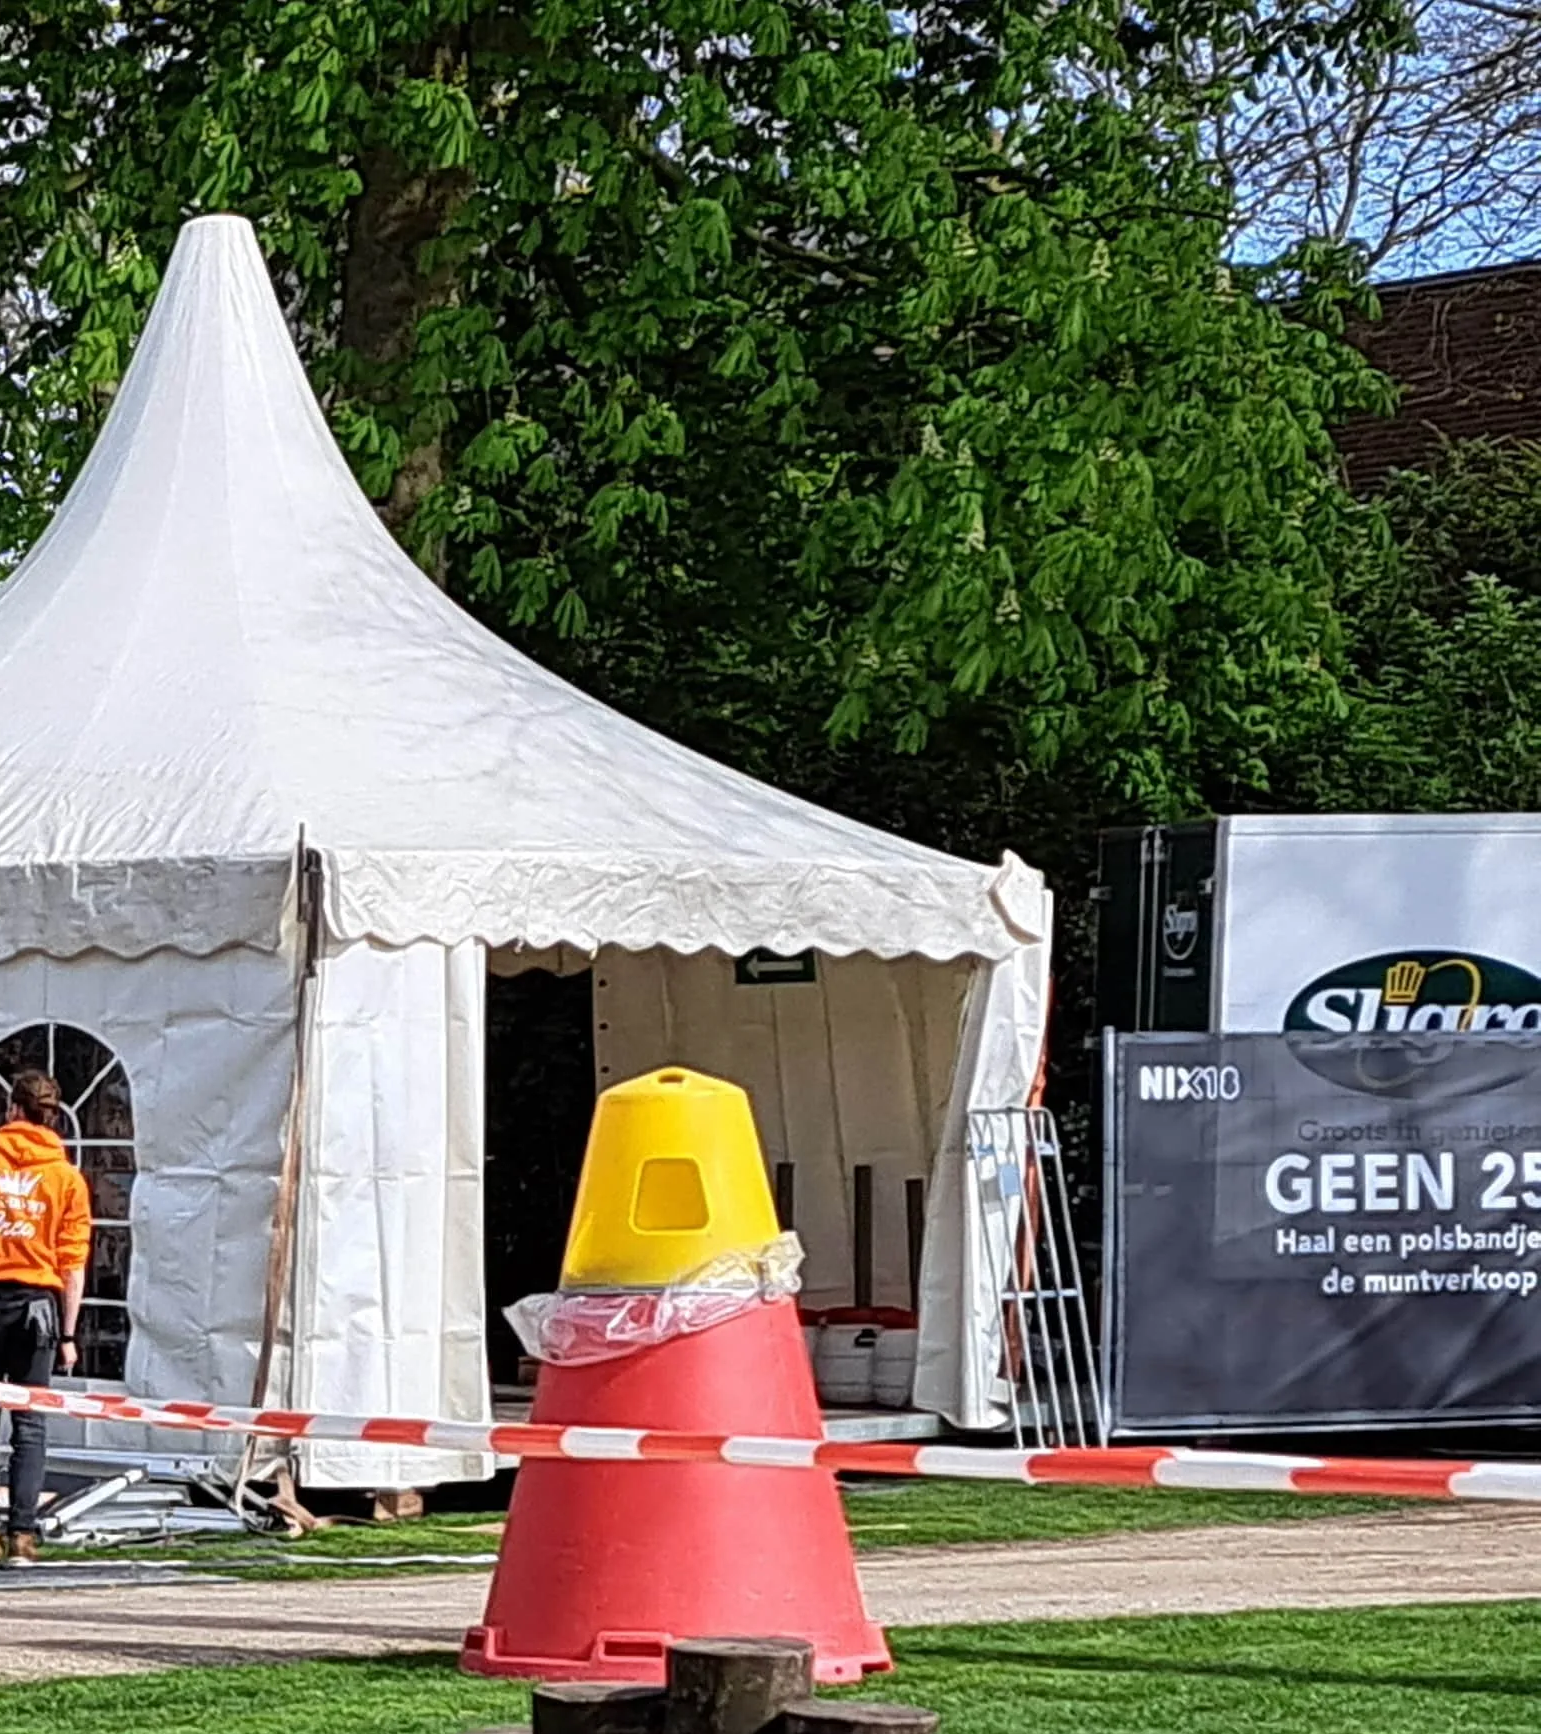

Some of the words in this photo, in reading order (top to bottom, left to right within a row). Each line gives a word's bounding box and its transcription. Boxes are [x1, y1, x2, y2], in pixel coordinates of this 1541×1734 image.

[1140, 1064, 1240, 1100] NIX18
[1265, 1152, 1454, 1214] GEEN
[1480, 1151, 1541, 1210] 25
[1276, 1226, 1336, 1254] Haal
[1344, 1234, 1392, 1253] een
[1400, 1224, 1541, 1259] polsbandje
[1322, 1267, 1356, 1294] de
[1364, 1264, 1537, 1296] muntverkoop
